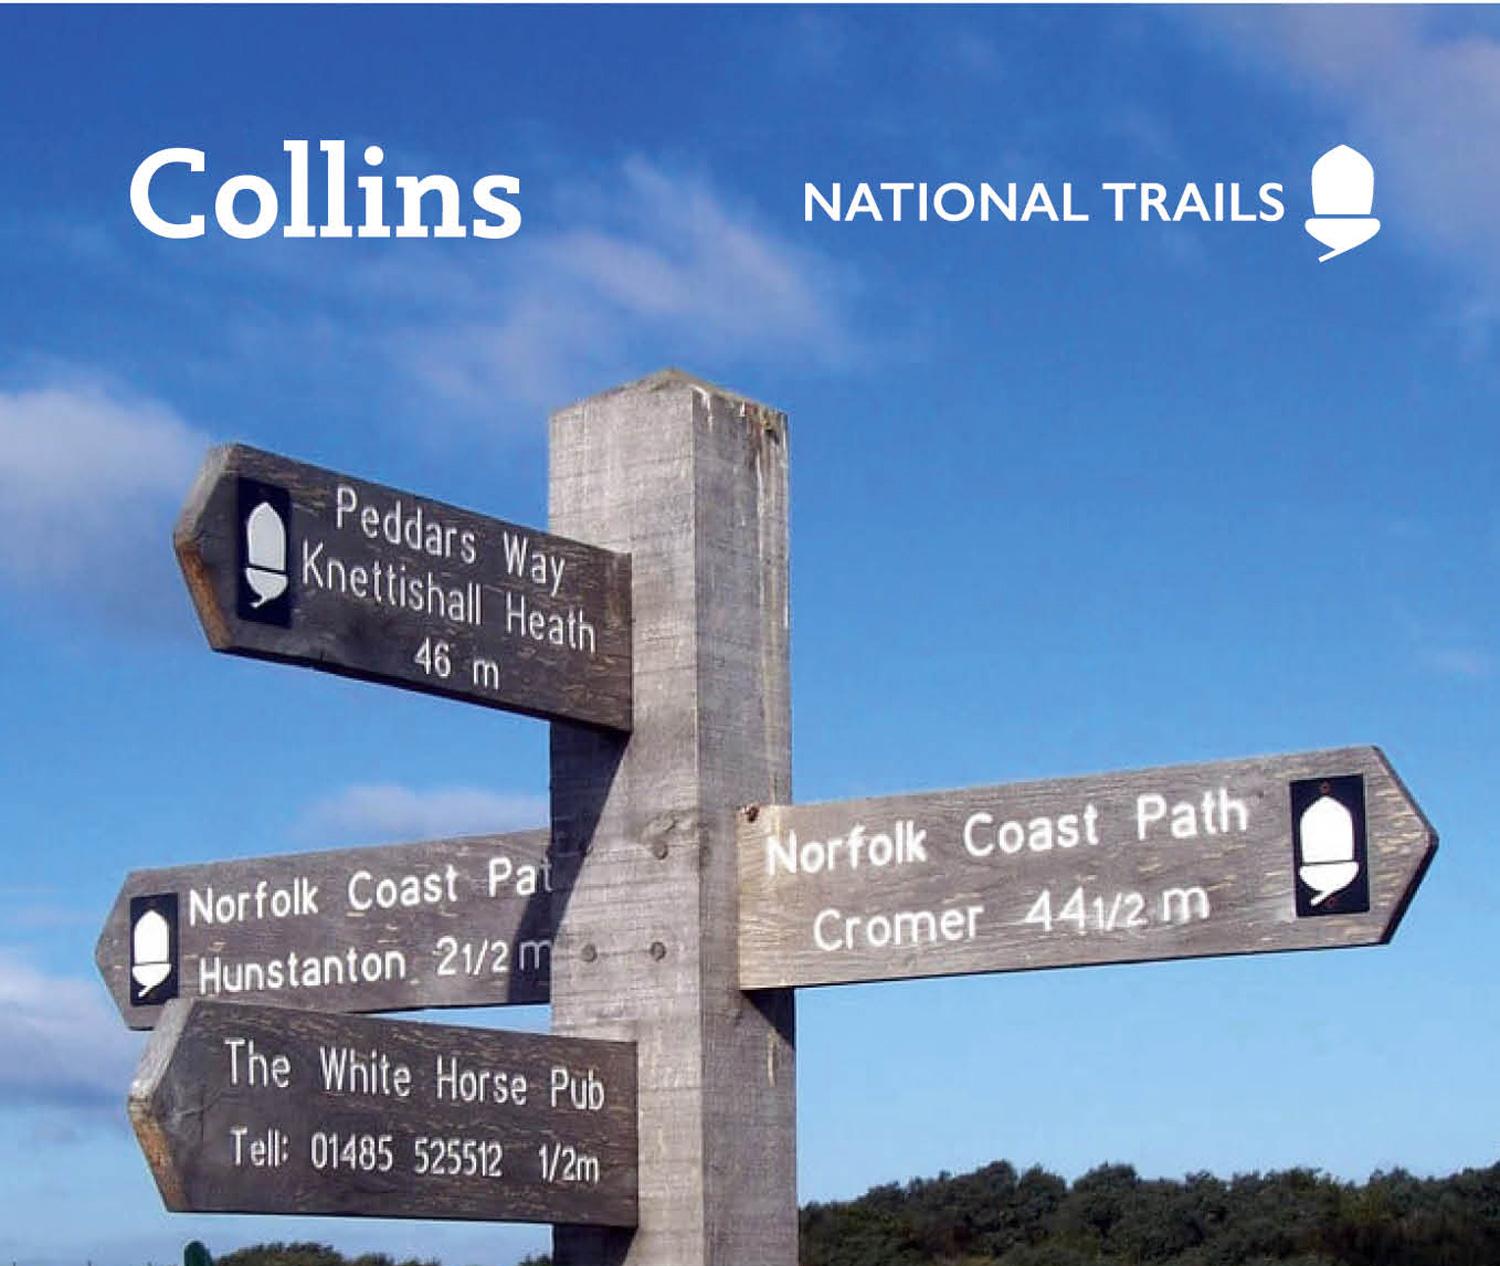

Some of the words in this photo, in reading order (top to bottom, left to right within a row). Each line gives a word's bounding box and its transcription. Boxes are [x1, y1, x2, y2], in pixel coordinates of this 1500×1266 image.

[335, 485, 477, 565] Peddars
[503, 531, 566, 597] Way
[301, 538, 482, 626] Knettishall
[504, 593, 597, 654] Heath
[414, 637, 452, 677] 46
[472, 657, 500, 690] m
[765, 820, 928, 876] Norfolk
[963, 804, 1099, 857] Coast
[1136, 788, 1248, 840] Path
[188, 878, 319, 926] Norfolk
[347, 864, 458, 911] Coast
[488, 855, 552, 898] Pat
[812, 904, 984, 952] Cromer
[1161, 884, 1211, 922] m
[198, 947, 405, 995] Hunstanton
[435, 936, 509, 977] 21/2
[224, 1037, 291, 1089] The
[318, 1045, 412, 1098] White
[435, 1057, 528, 1107] Horse
[550, 1067, 605, 1112] Pub
[230, 1126, 289, 1168] Tell:
[310, 1131, 394, 1173] 01485
[413, 1137, 503, 1179] 525512
[537, 1147, 600, 1184] 1/2m
